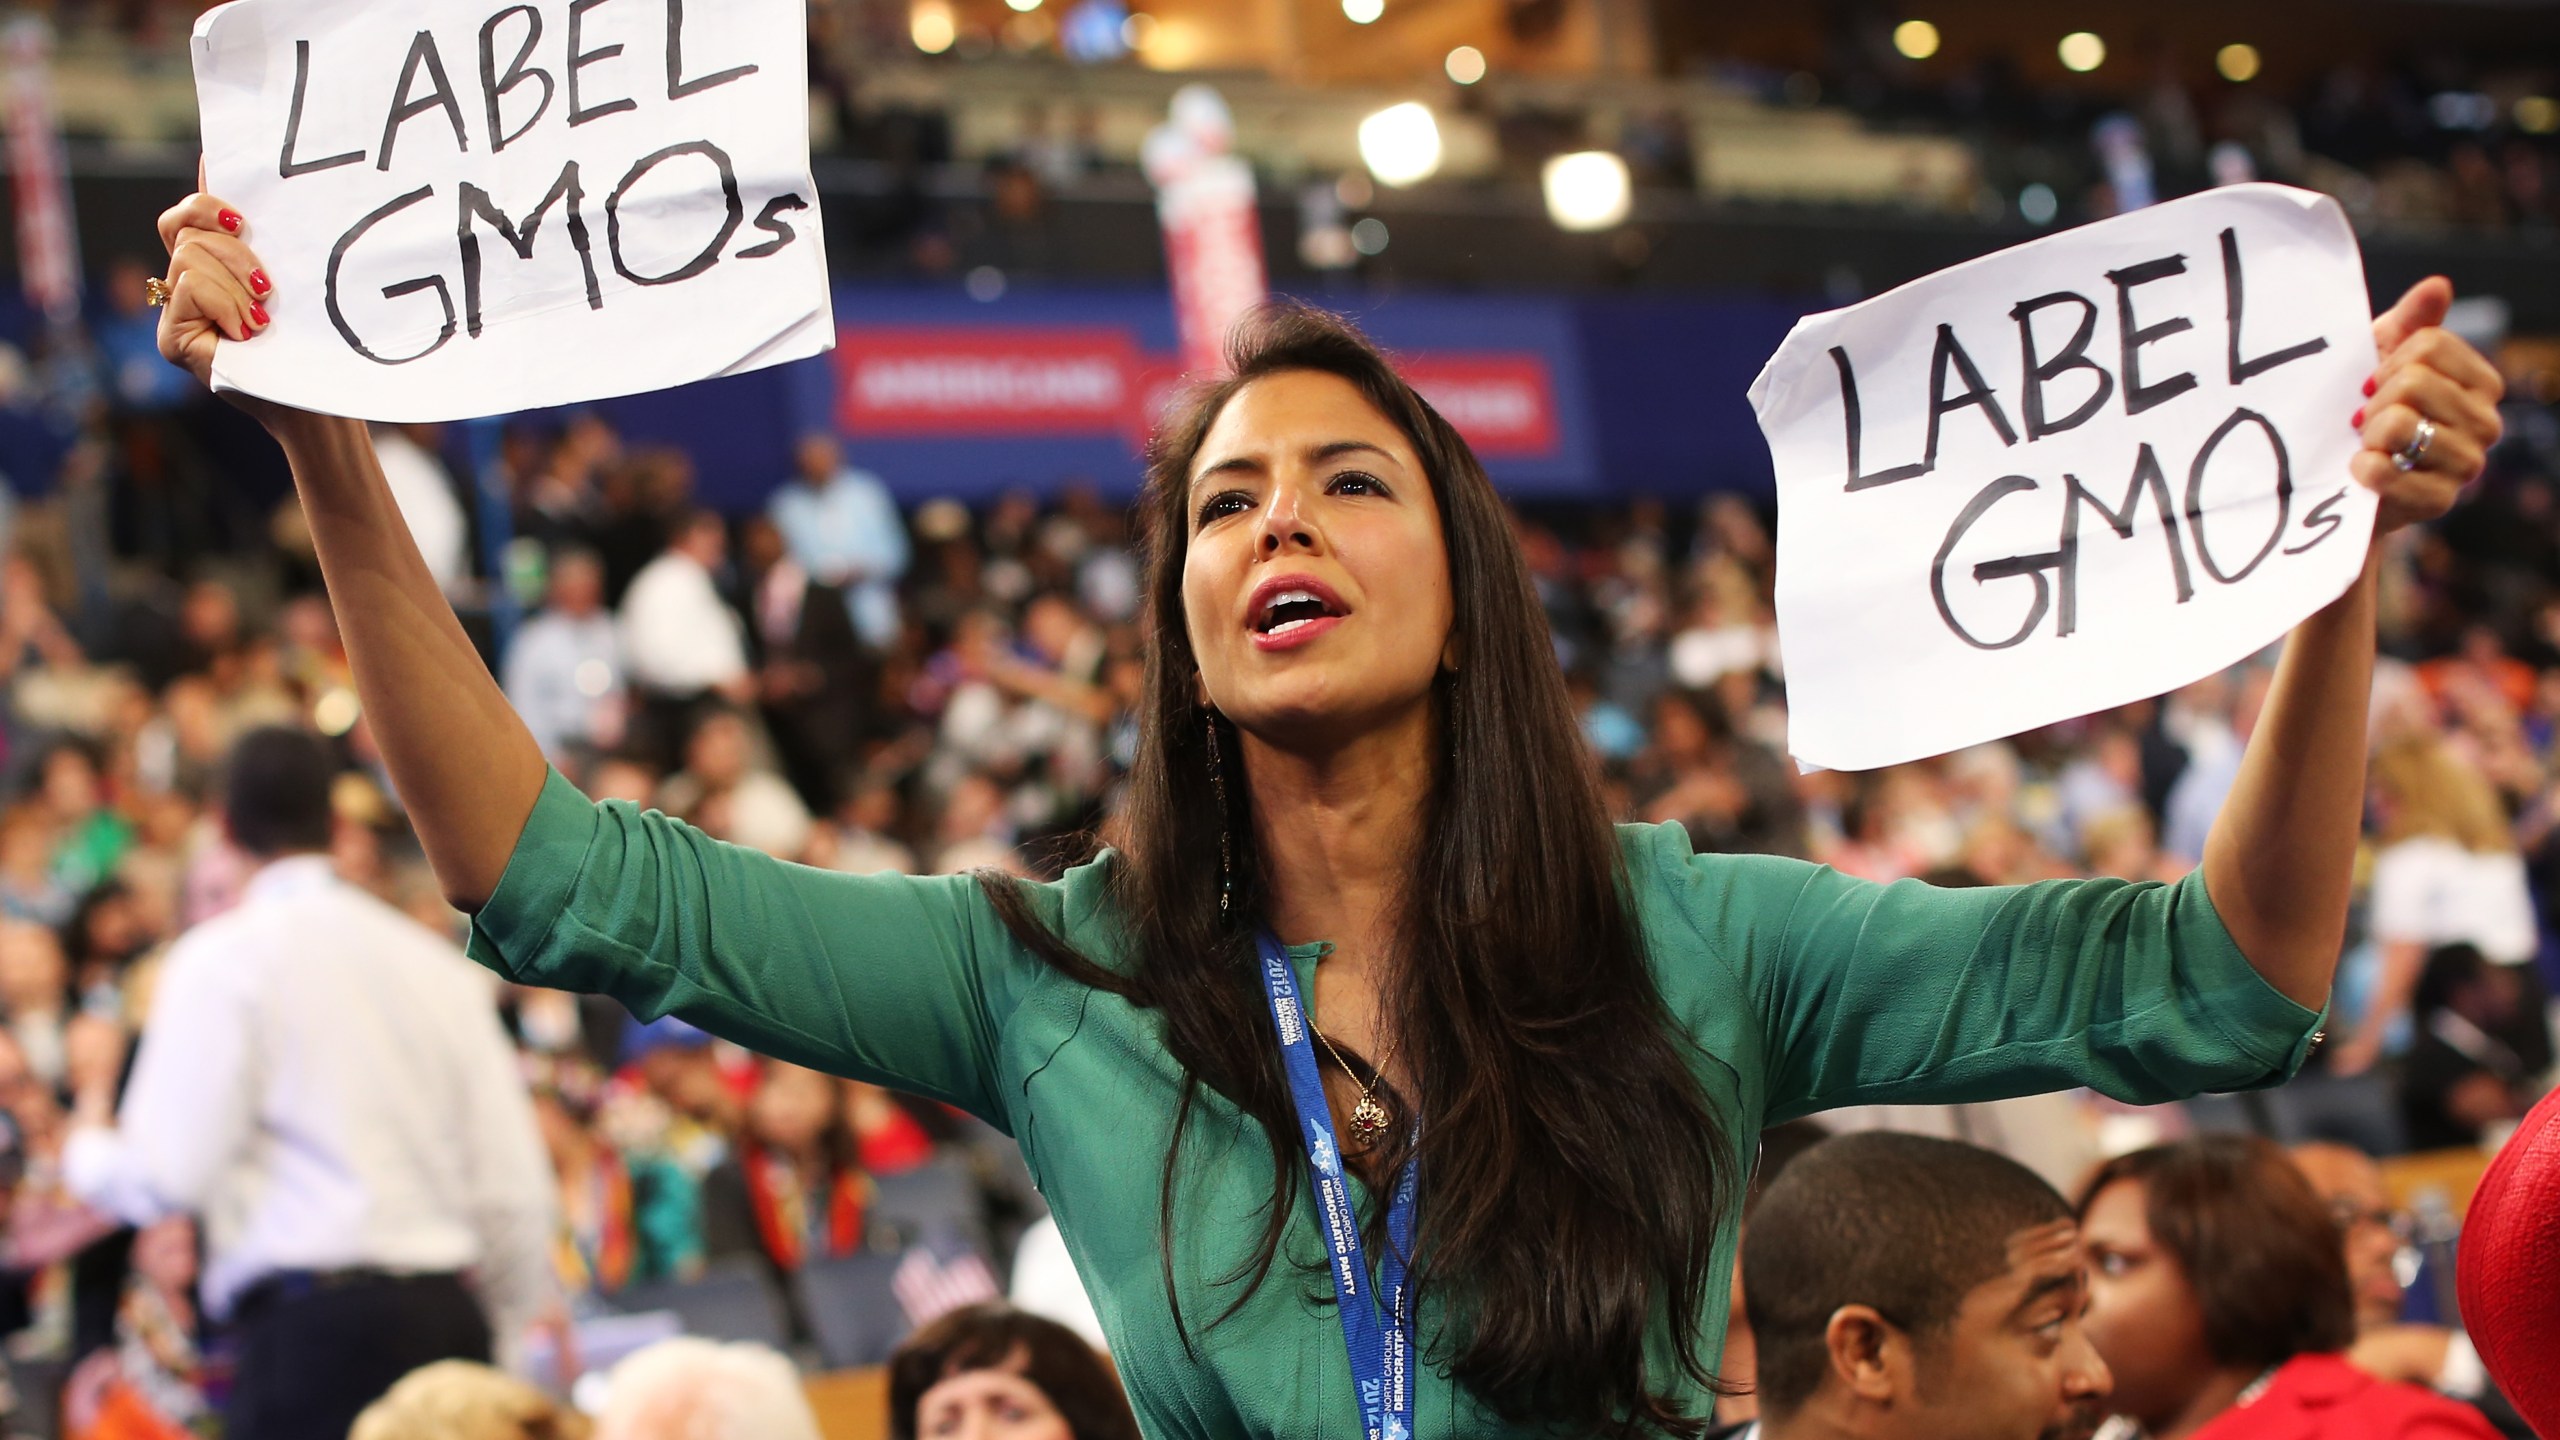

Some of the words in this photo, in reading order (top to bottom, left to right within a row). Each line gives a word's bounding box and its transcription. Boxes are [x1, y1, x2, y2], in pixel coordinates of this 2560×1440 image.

[279, 0, 758, 178] LABEL
[325, 140, 808, 365] GMOs
[1829, 227, 2329, 493] LABEL
[1931, 407, 2348, 651] GMOs
[1266, 958, 1293, 996] 2012
[1274, 998, 1291, 1046] CONVENTION
[1281, 998, 1298, 1045] NATIONAL
[1288, 996, 1304, 1041] DEMOCRATIC
[1321, 1179, 1346, 1254] DEMOCRATIC
[1339, 1256, 1356, 1296] PARTY
[1332, 1176, 1346, 1207] NORTH
[1340, 1208, 1356, 1251] CAROLINA
[1384, 1330, 1392, 1377] CAROLINA
[1394, 1329, 1404, 1411] DEMOCRATIC
[1383, 1379, 1392, 1413] NORTH
